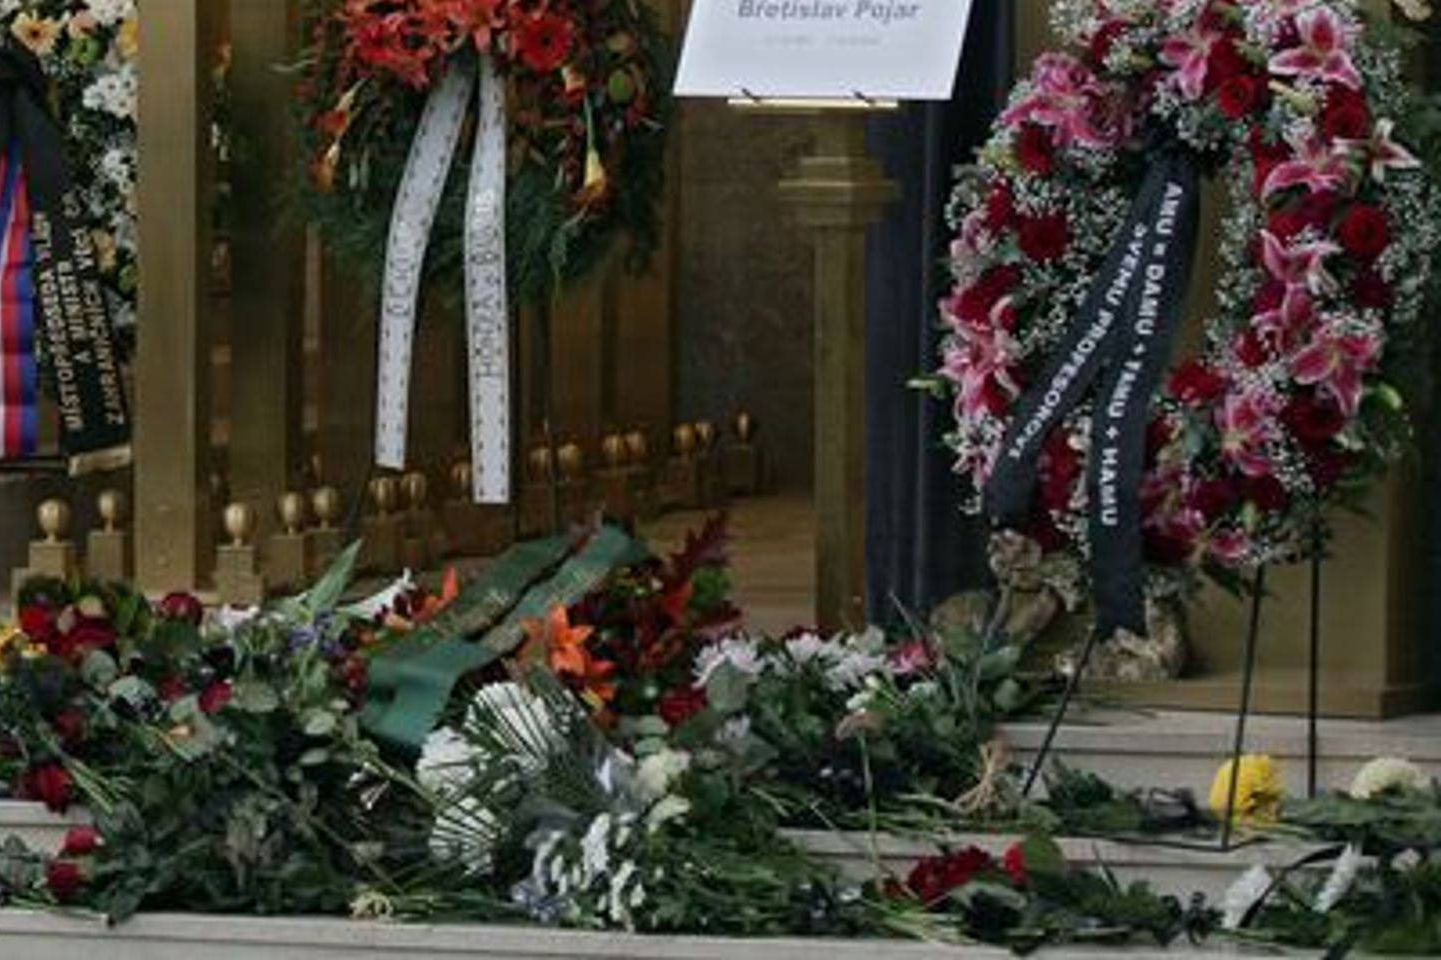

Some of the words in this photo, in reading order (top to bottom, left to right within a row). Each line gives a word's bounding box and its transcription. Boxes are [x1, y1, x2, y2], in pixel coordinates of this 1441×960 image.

[1156, 182, 1184, 234] AMU
[1134, 264, 1165, 335] DAMU
[1099, 447, 1119, 526] HAMU
